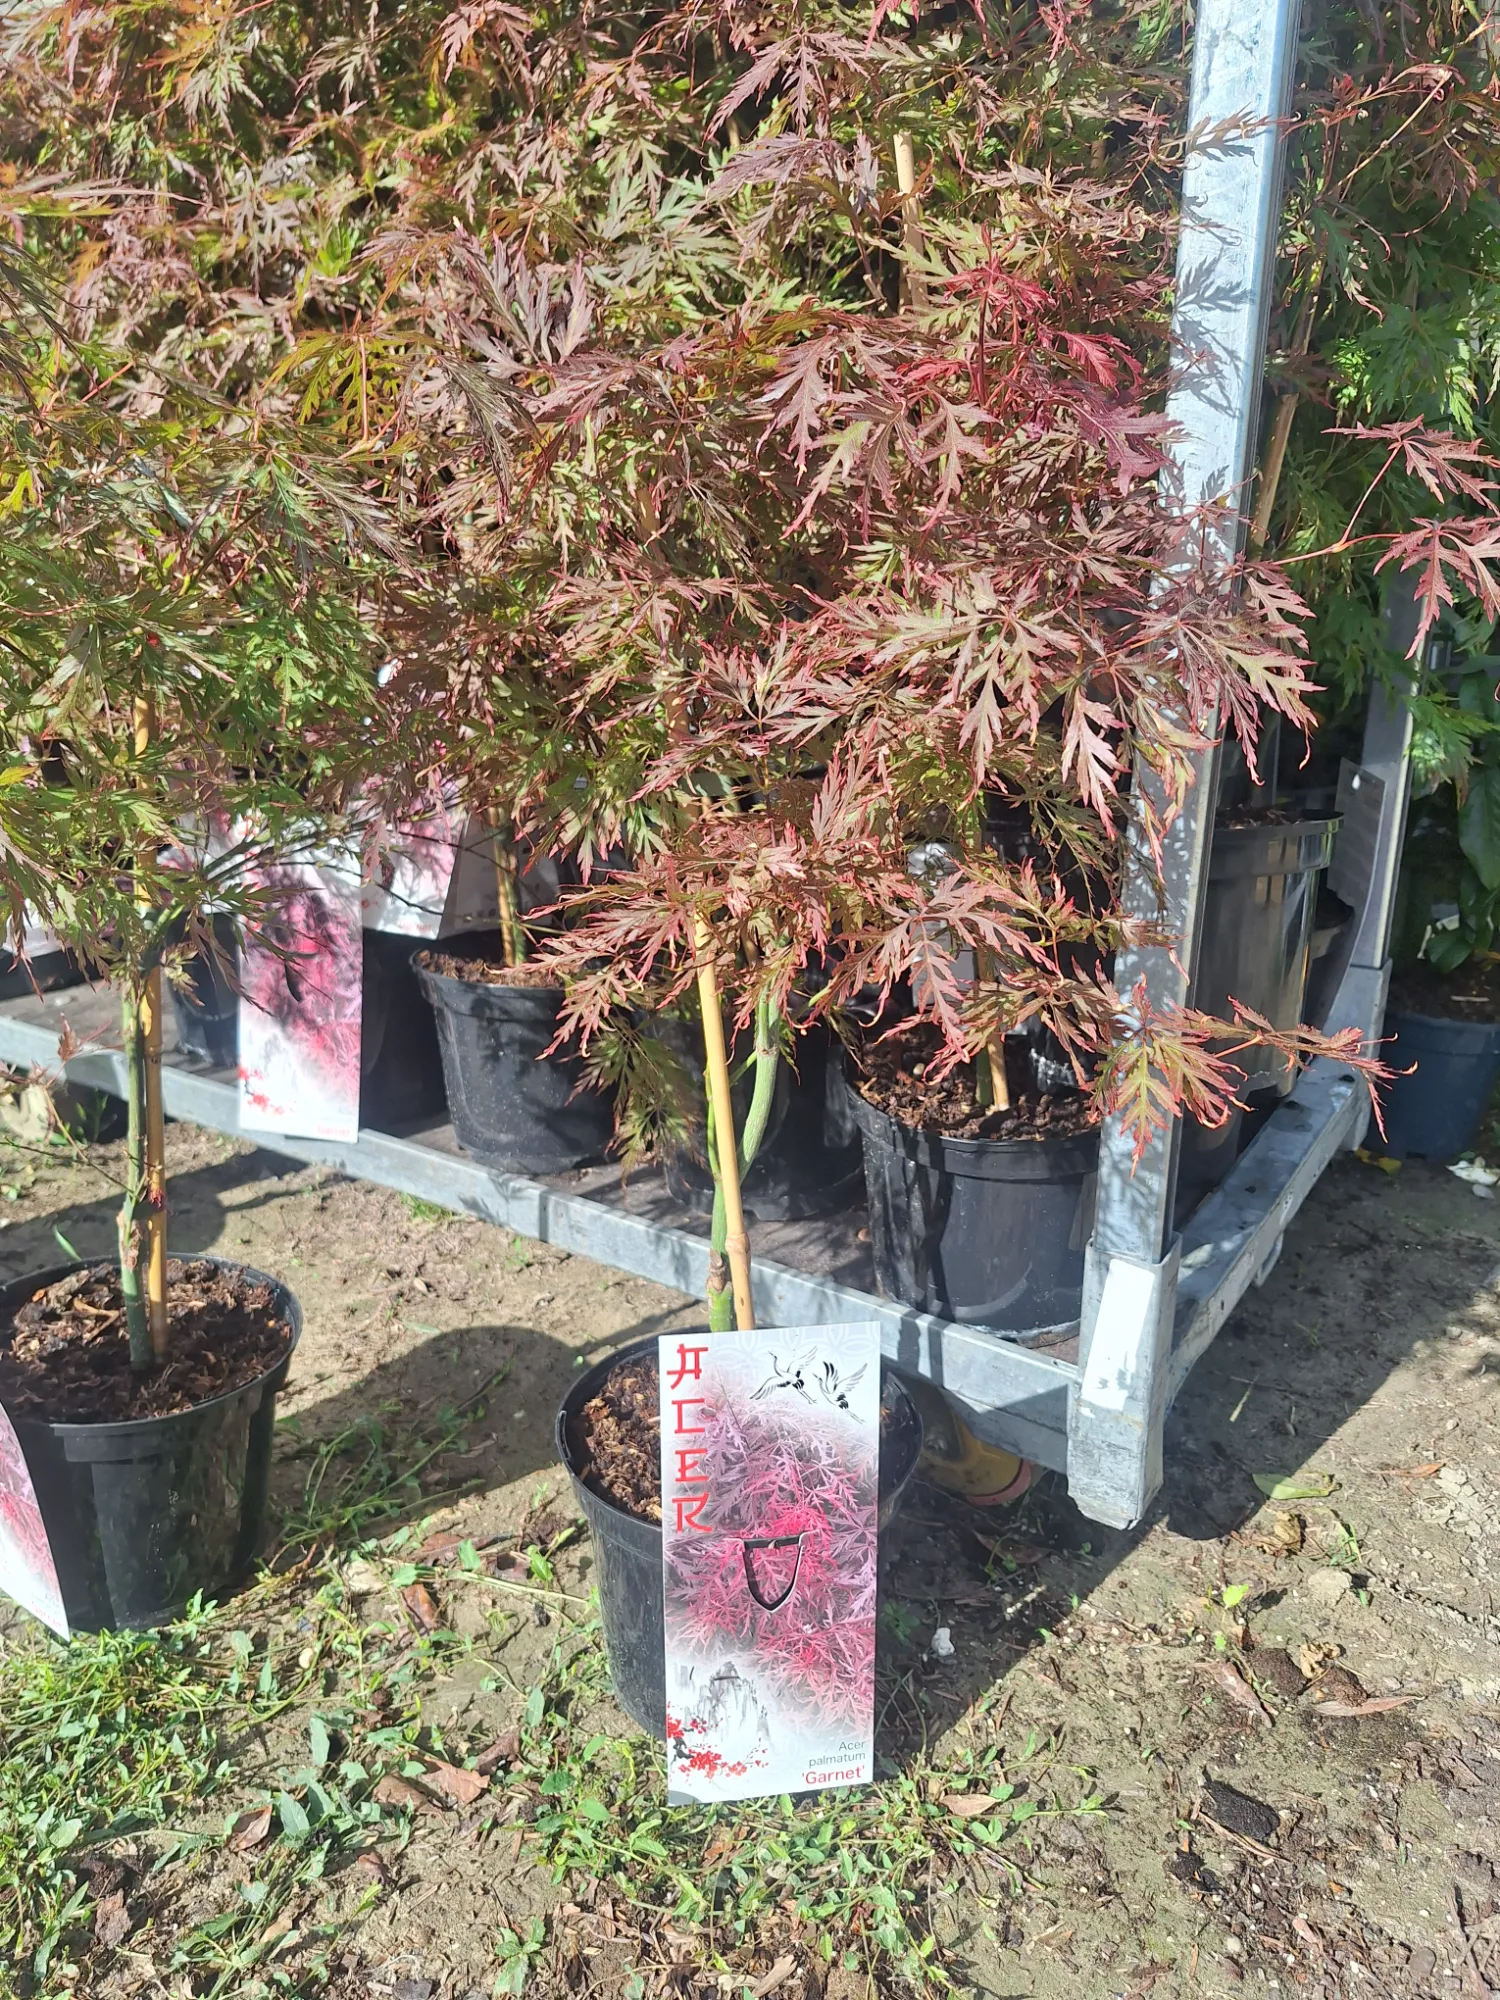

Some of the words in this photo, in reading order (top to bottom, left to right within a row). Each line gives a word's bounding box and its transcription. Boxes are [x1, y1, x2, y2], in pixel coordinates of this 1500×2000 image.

[666, 1343, 713, 1533] ACER
[838, 1741, 866, 1752] Acer
[808, 1752, 866, 1769] palmatum
[801, 1764, 865, 1785] 'Garnet'
